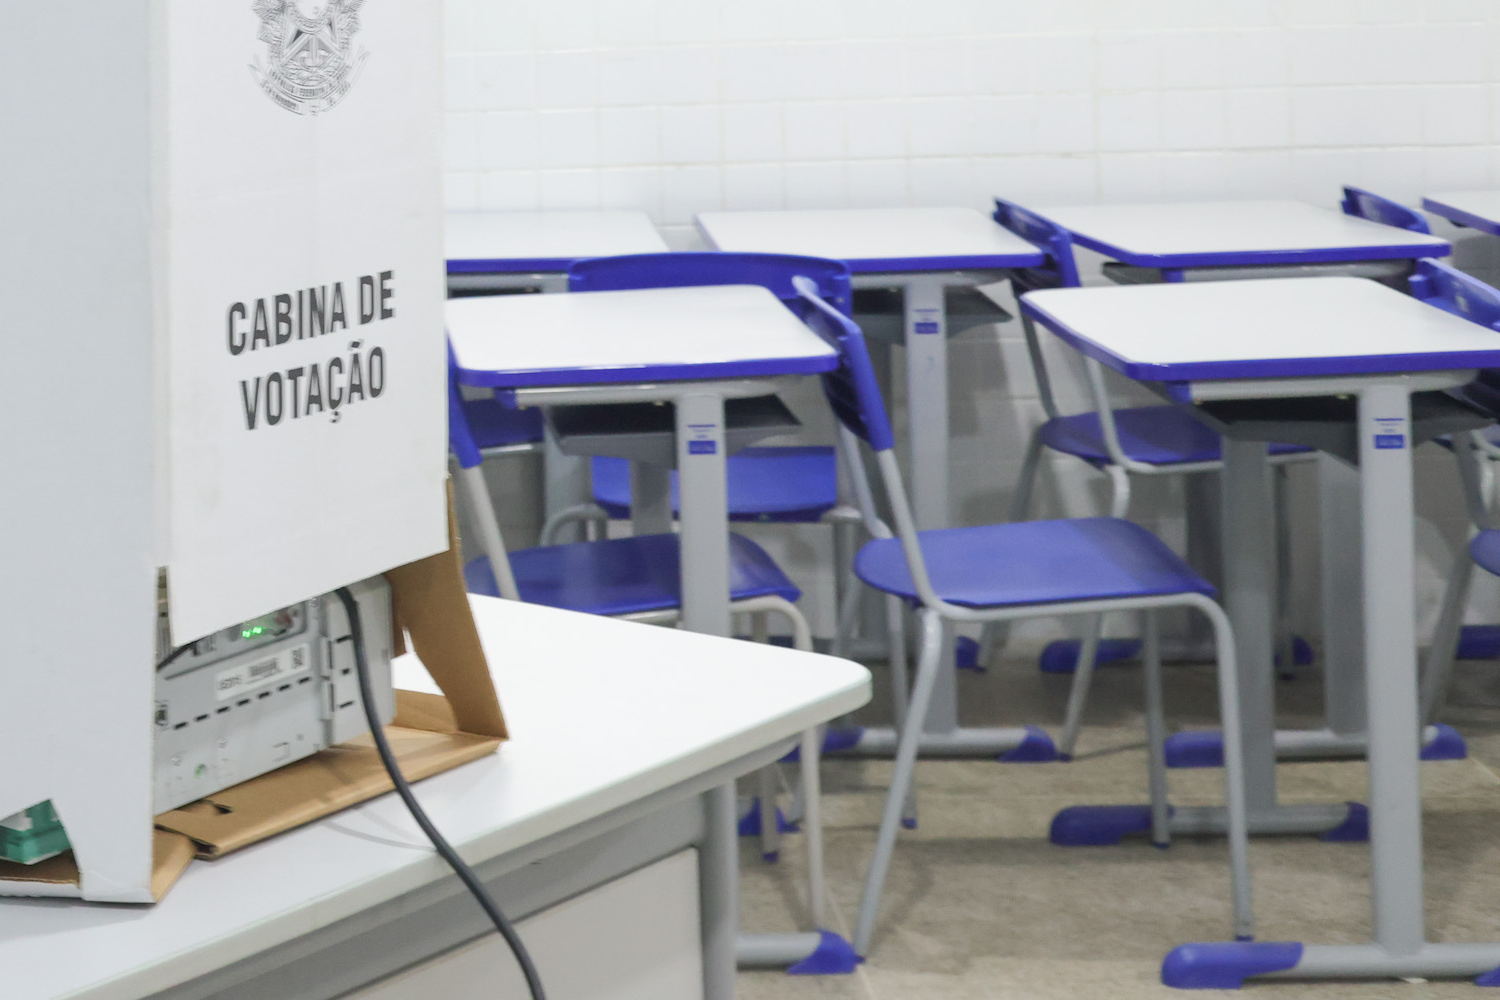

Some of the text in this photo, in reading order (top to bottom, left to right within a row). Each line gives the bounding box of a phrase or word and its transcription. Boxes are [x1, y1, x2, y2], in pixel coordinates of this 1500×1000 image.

[226, 270, 395, 356] CABINA DE
[239, 339, 386, 430] VOTAÇÃO
